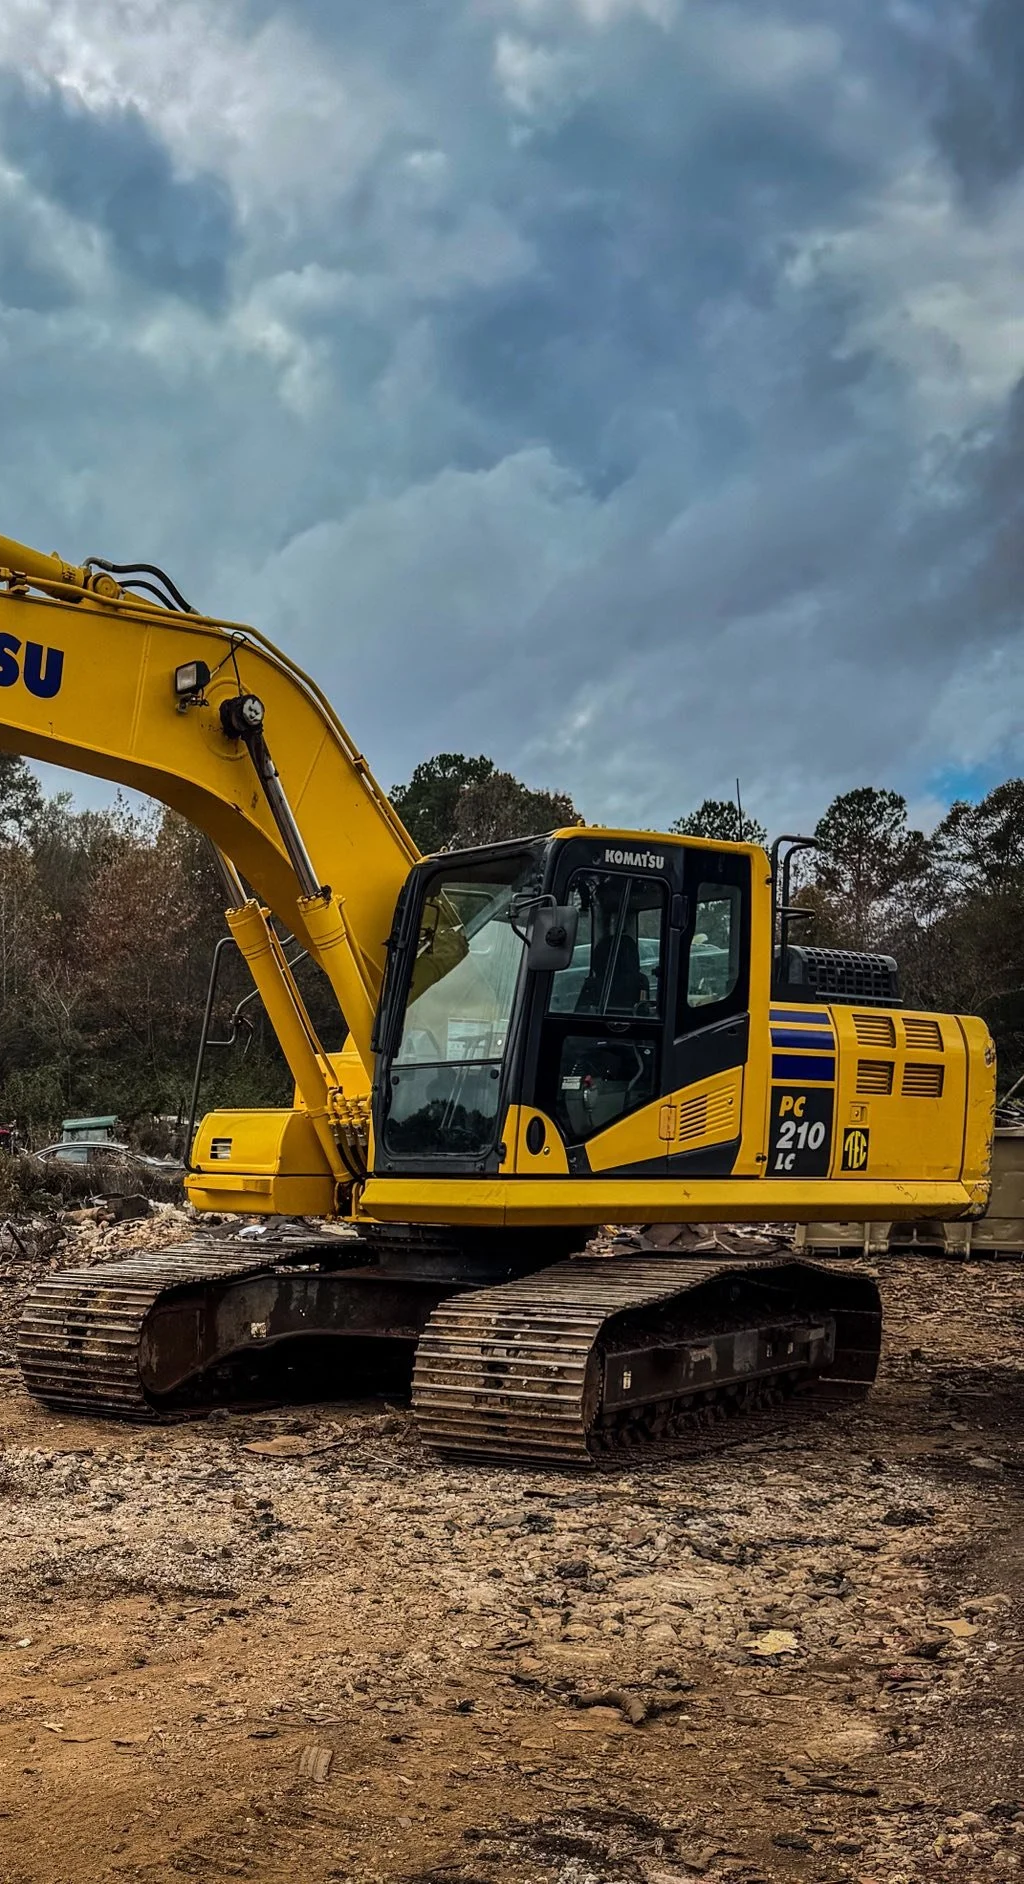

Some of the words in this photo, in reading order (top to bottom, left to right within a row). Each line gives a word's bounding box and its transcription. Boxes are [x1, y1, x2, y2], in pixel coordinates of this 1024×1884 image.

[604, 849, 665, 870] KOMATSU
[778, 1095, 807, 1118] PC
[775, 1120, 826, 1150] 210
[844, 1129, 868, 1170] TEC
[773, 1152, 796, 1171] LC
